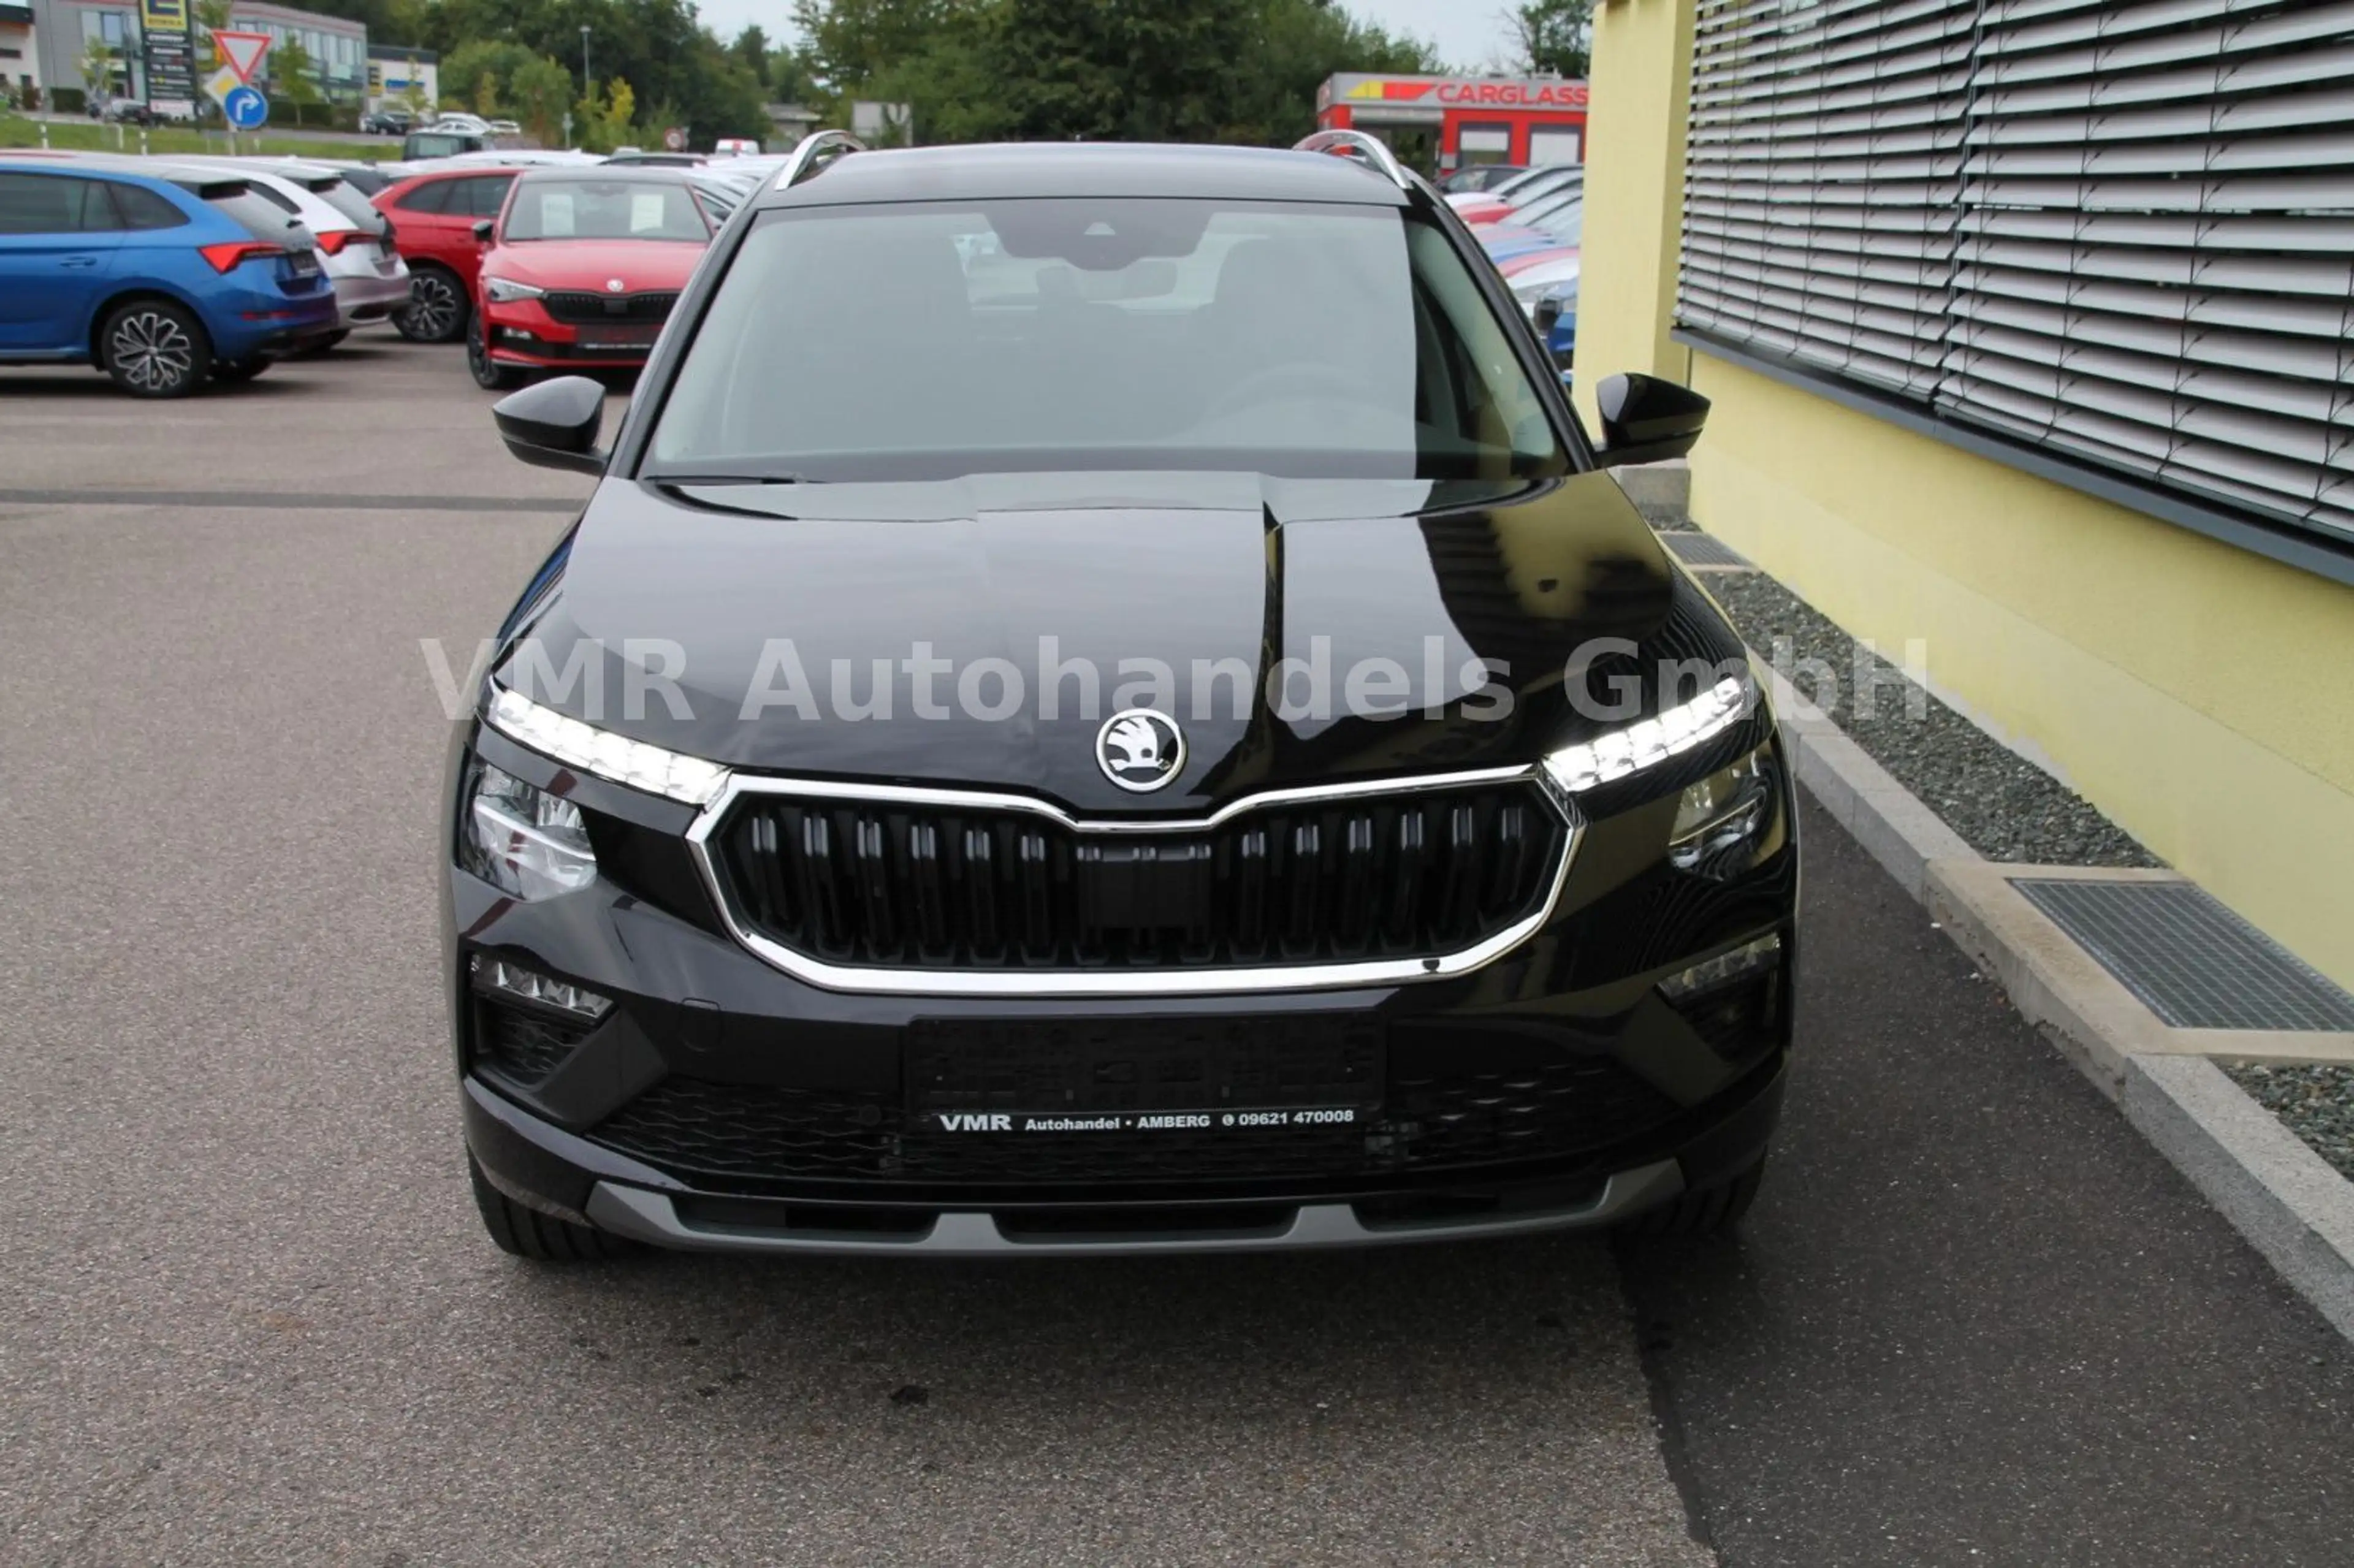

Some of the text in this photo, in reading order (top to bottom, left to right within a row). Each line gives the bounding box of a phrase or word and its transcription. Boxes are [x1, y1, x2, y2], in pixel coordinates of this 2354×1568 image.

[1437, 83, 1588, 106] CARGLASS
[939, 1109, 1354, 1131] VMR Autohandel AMBERG 09621 470008
